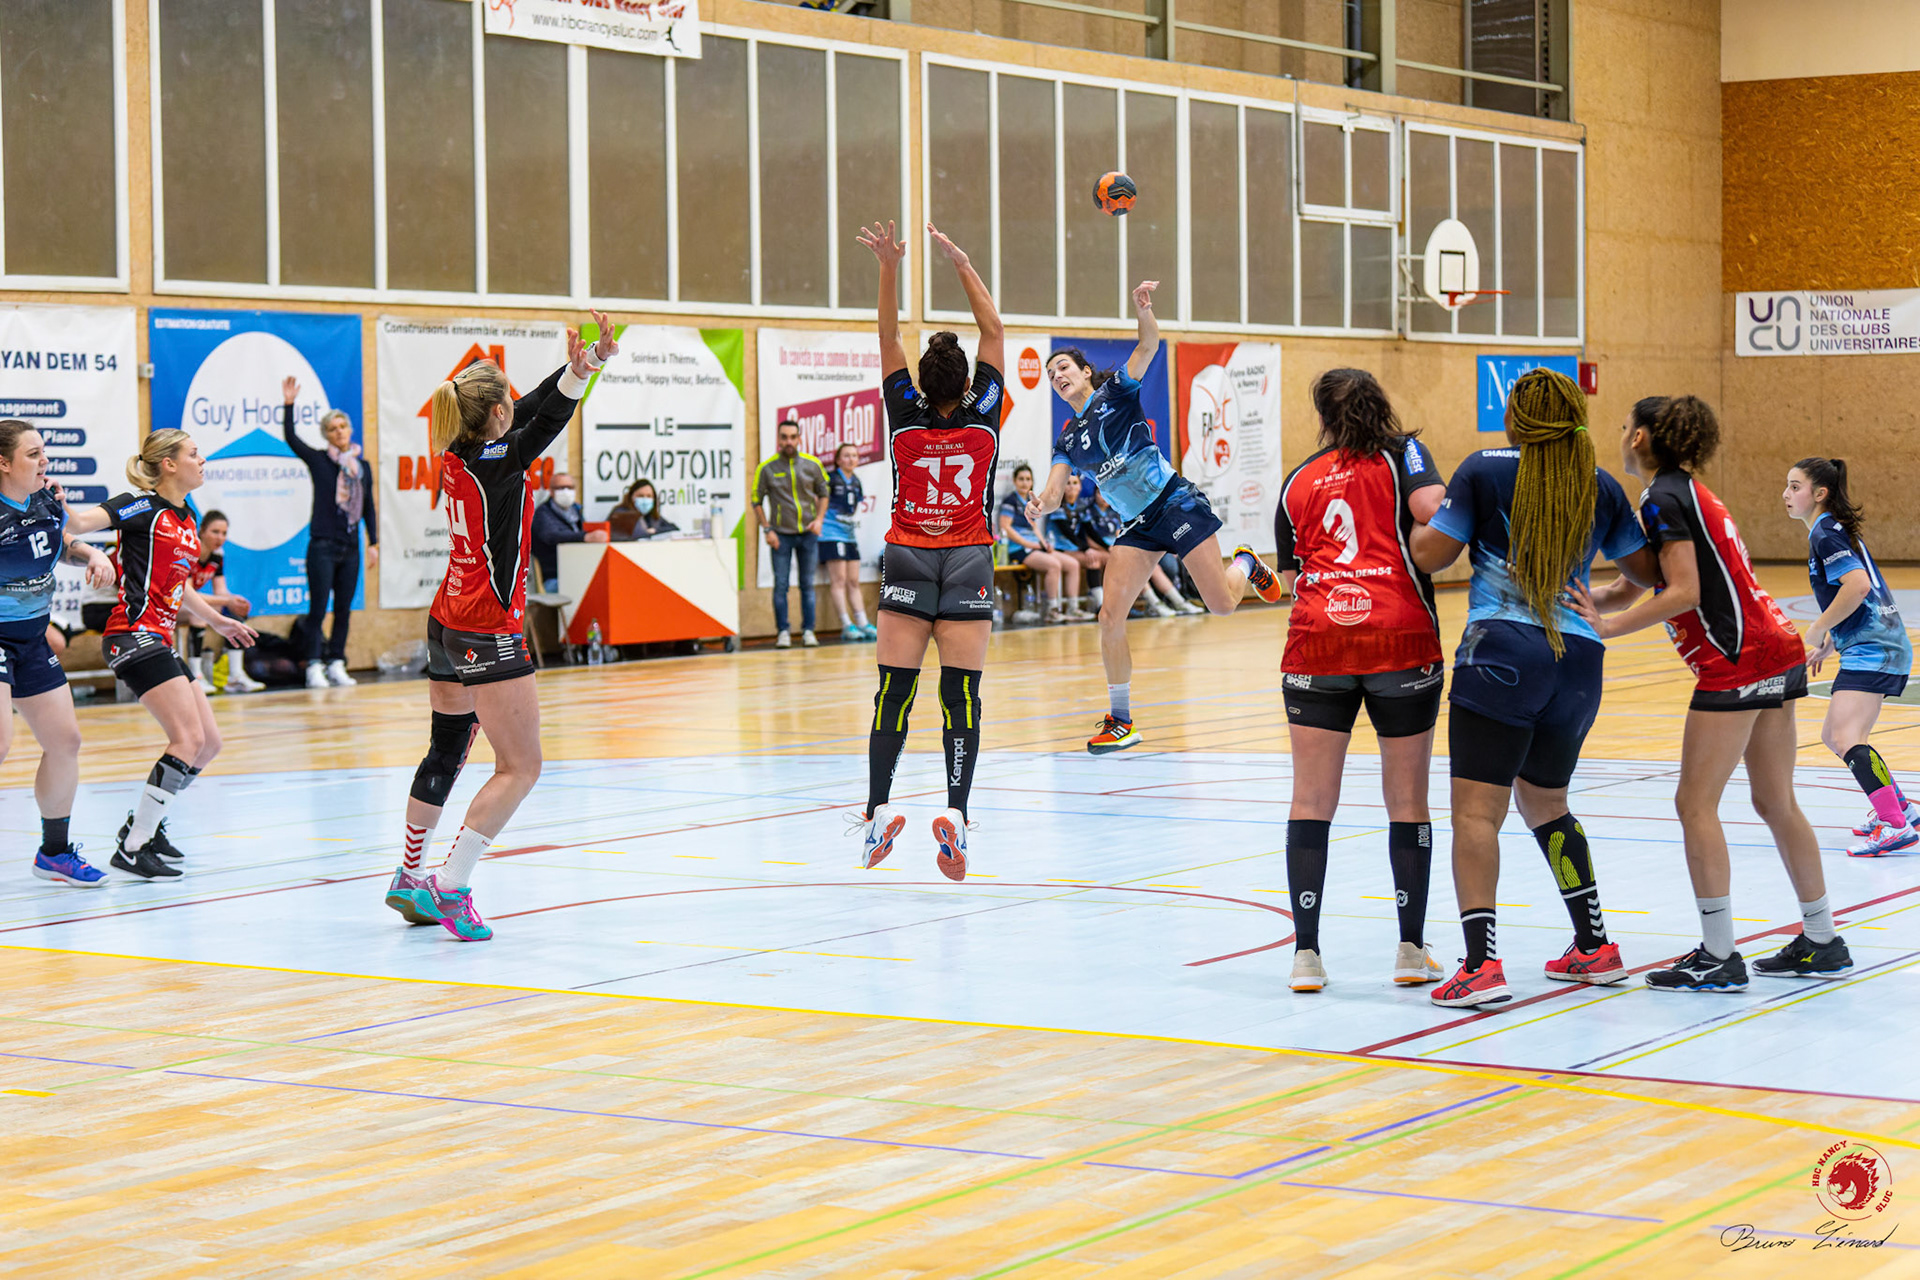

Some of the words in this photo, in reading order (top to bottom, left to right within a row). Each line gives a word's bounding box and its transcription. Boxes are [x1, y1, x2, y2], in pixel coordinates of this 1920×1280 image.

[1810, 295, 1853, 307] UNION
[1810, 308, 1890, 321] NATIONALE
[452, 324, 498, 337] ensemble
[530, 327, 558, 339] avenir
[1810, 323, 1837, 336] DES
[1842, 322, 1890, 336] CLUBS
[1810, 337, 1920, 351] UNIVERSITAIRE
[46, 352, 87, 370] DEM
[95, 353, 118, 371] 54
[1019, 357, 1040, 369] DEVIS
[192, 397, 235, 431] Guy
[654, 417, 674, 436] LE
[834, 395, 875, 451] Léon
[1080, 428, 1092, 451] 5
[596, 450, 732, 482] COMPTOIR
[912, 453, 975, 506] 13
[917, 507, 946, 516] RAYAN
[28, 530, 52, 559] 12
[891, 593, 916, 605] SPORT
[892, 586, 916, 599] INTER
[1328, 598, 1348, 613] Cave
[1351, 597, 1372, 611] Léon
[1758, 675, 1786, 687] INTER
[1756, 684, 1785, 695] SPORT
[950, 738, 967, 787] Kempa
